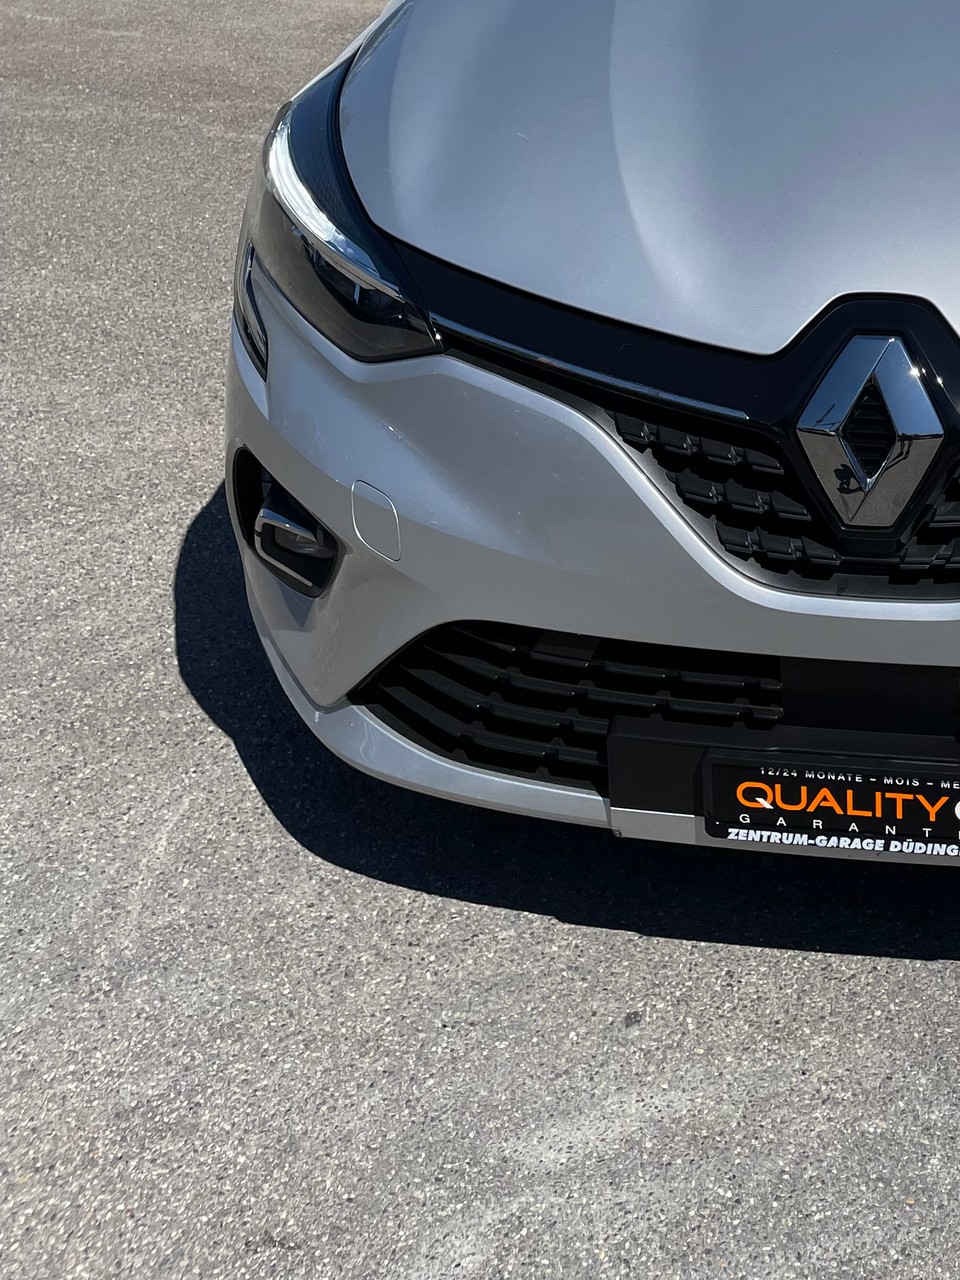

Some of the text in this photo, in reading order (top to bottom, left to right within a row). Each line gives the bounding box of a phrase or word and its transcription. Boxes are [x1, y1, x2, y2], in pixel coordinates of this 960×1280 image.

[760, 767, 798, 777] 12/24
[805, 770, 863, 782] MONATE
[883, 776, 919, 786] MOIS
[736, 781, 950, 822] QUALITY
[727, 828, 885, 851] ZENTRUM-GARAGE
